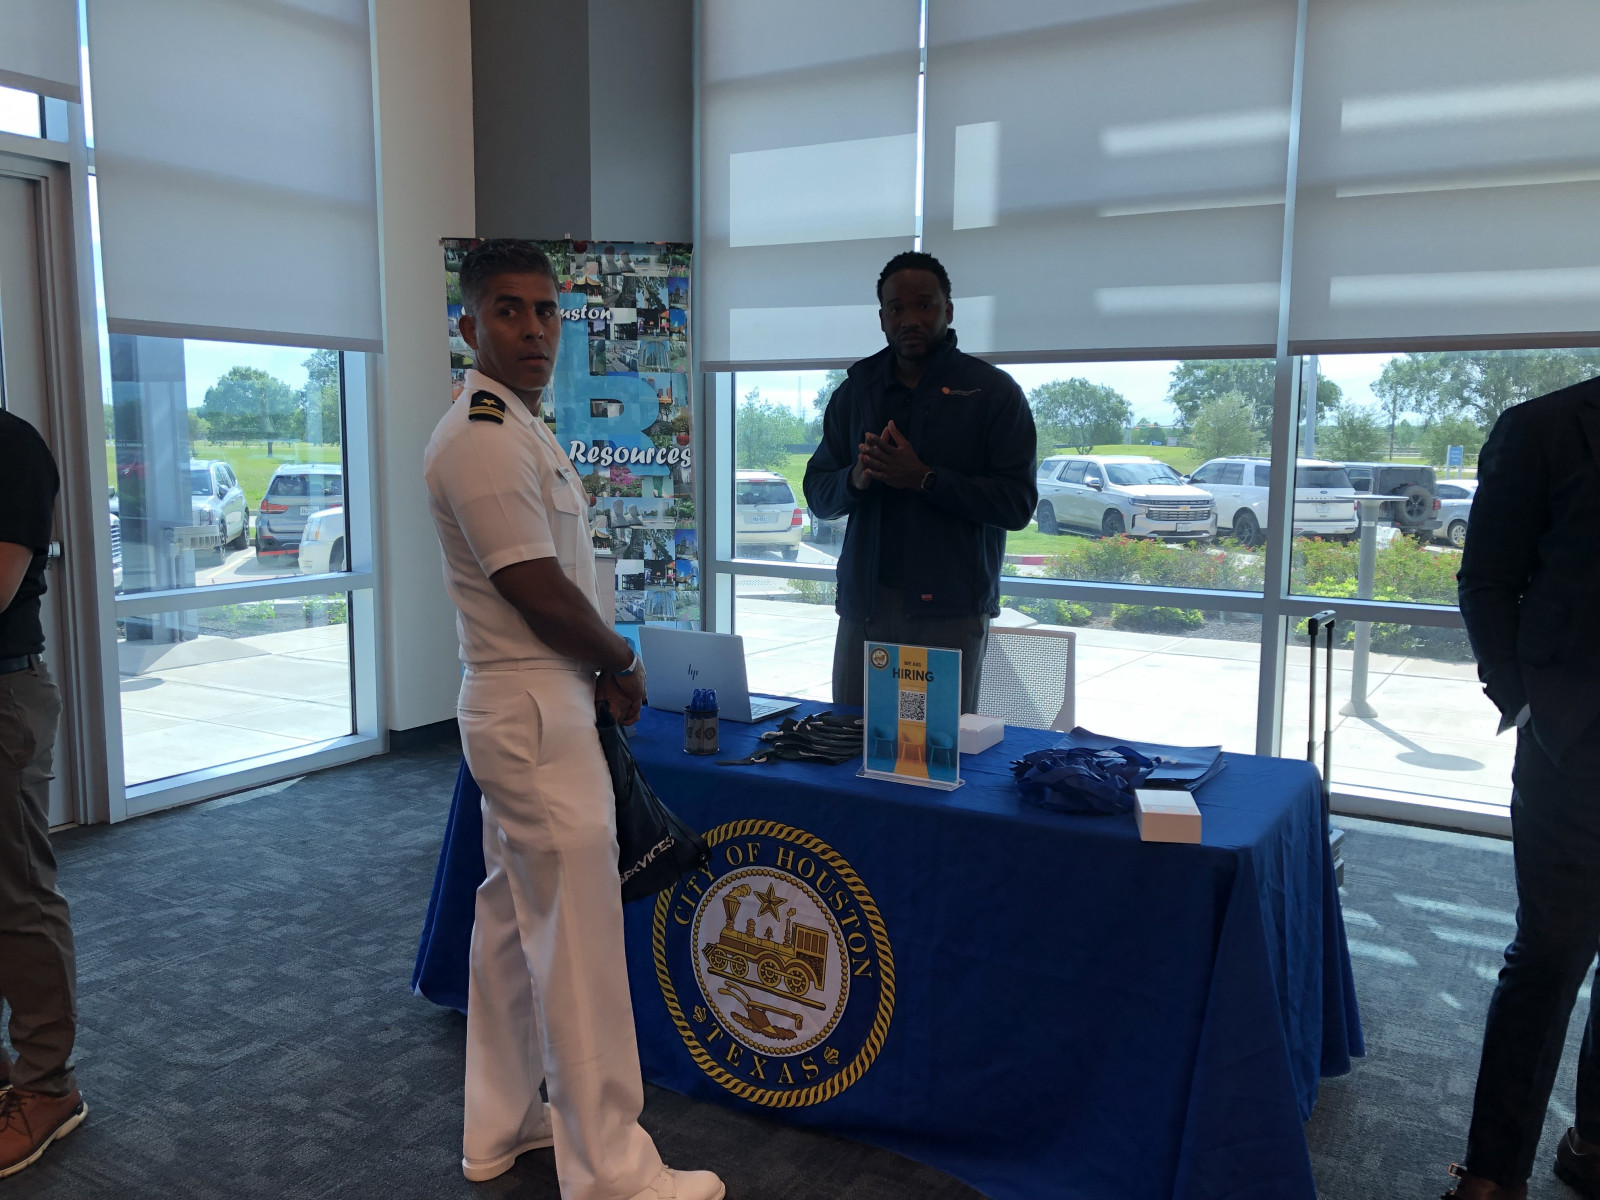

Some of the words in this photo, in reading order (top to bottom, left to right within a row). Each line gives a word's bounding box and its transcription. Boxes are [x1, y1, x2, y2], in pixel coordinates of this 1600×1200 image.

[568, 440, 691, 468] Resources
[687, 663, 699, 681] hp
[892, 667, 934, 682] HIRING
[674, 862, 715, 926] CITY
[726, 842, 761, 866] OF
[777, 847, 873, 979] HOUSTON
[705, 1022, 819, 1084] TEXAS
